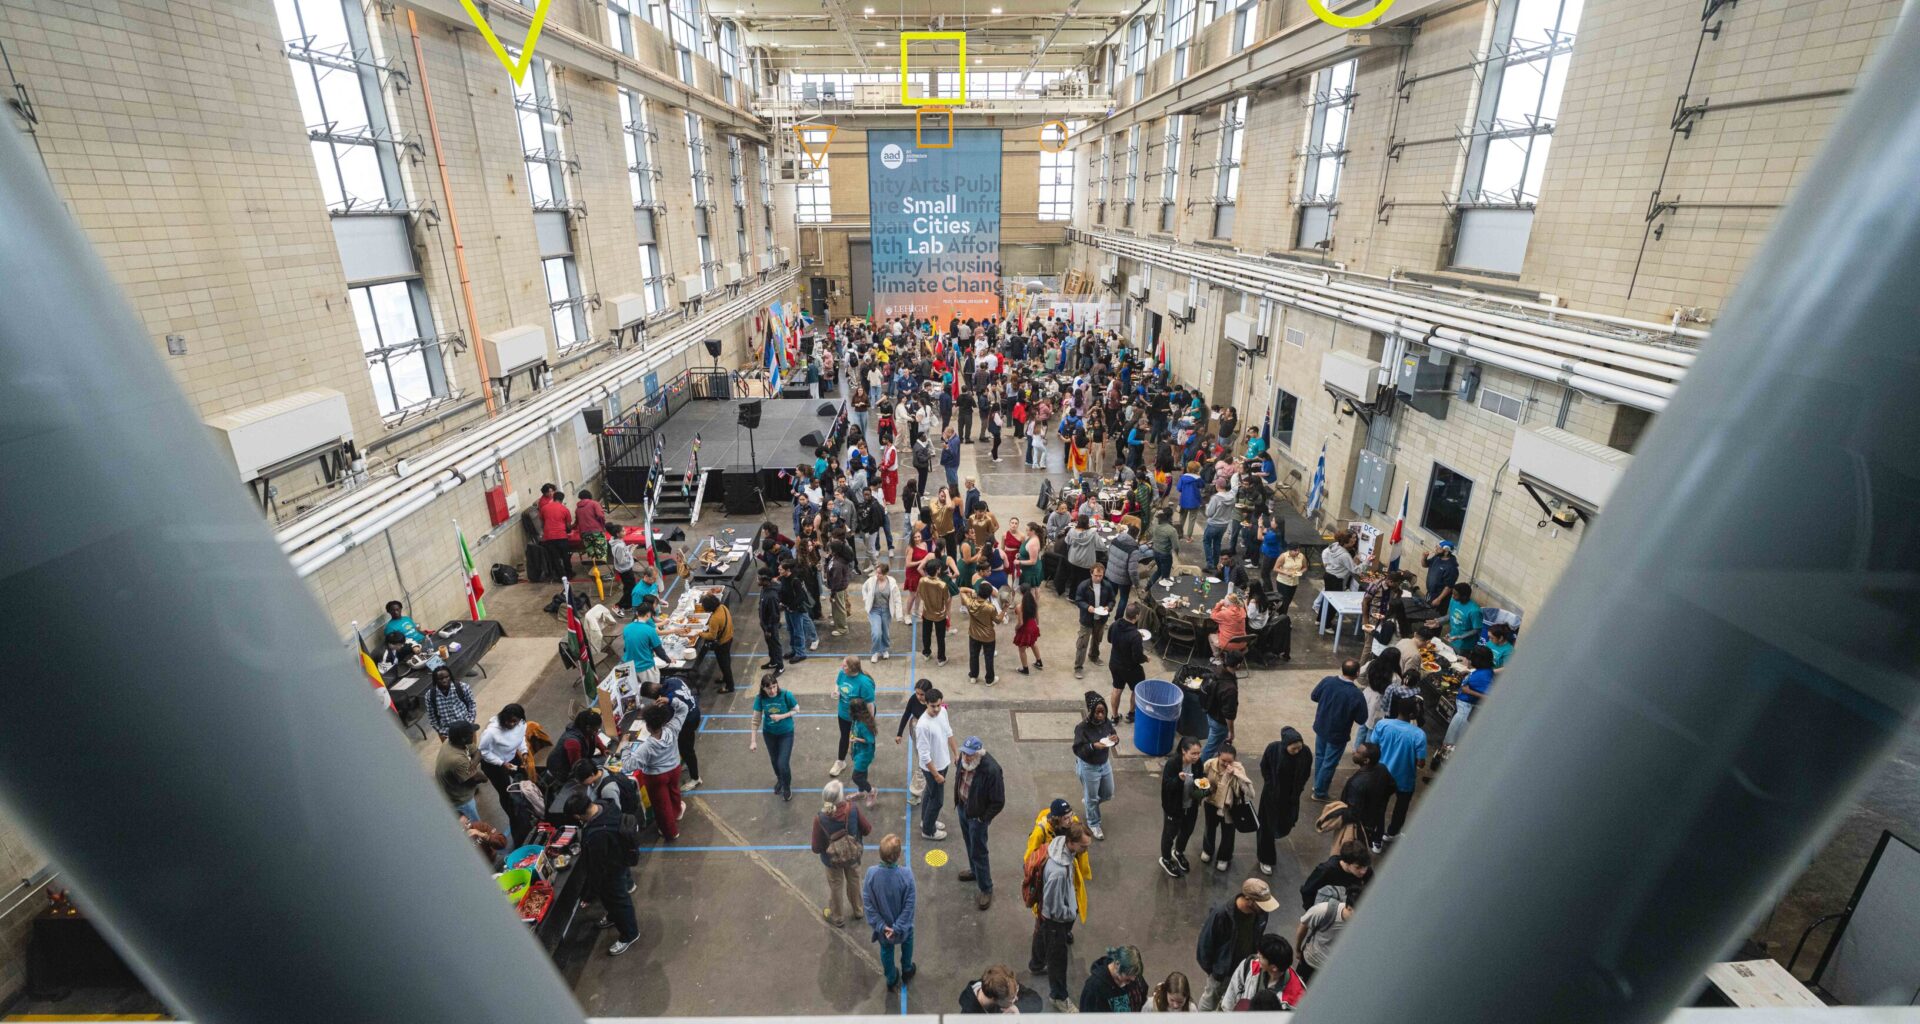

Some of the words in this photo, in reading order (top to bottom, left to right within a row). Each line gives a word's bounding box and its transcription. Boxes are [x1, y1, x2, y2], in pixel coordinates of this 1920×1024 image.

[883, 150, 900, 160] aad
[909, 177, 949, 193] Arts
[902, 194, 956, 214] Small
[913, 215, 970, 234] Cities
[975, 217, 1000, 233] Ar
[872, 236, 903, 254] lth
[907, 235, 943, 254] Lab
[947, 235, 1000, 253] Affor
[927, 256, 1002, 277] Housing
[872, 275, 938, 293] limate
[894, 304, 928, 313] LEHGH
